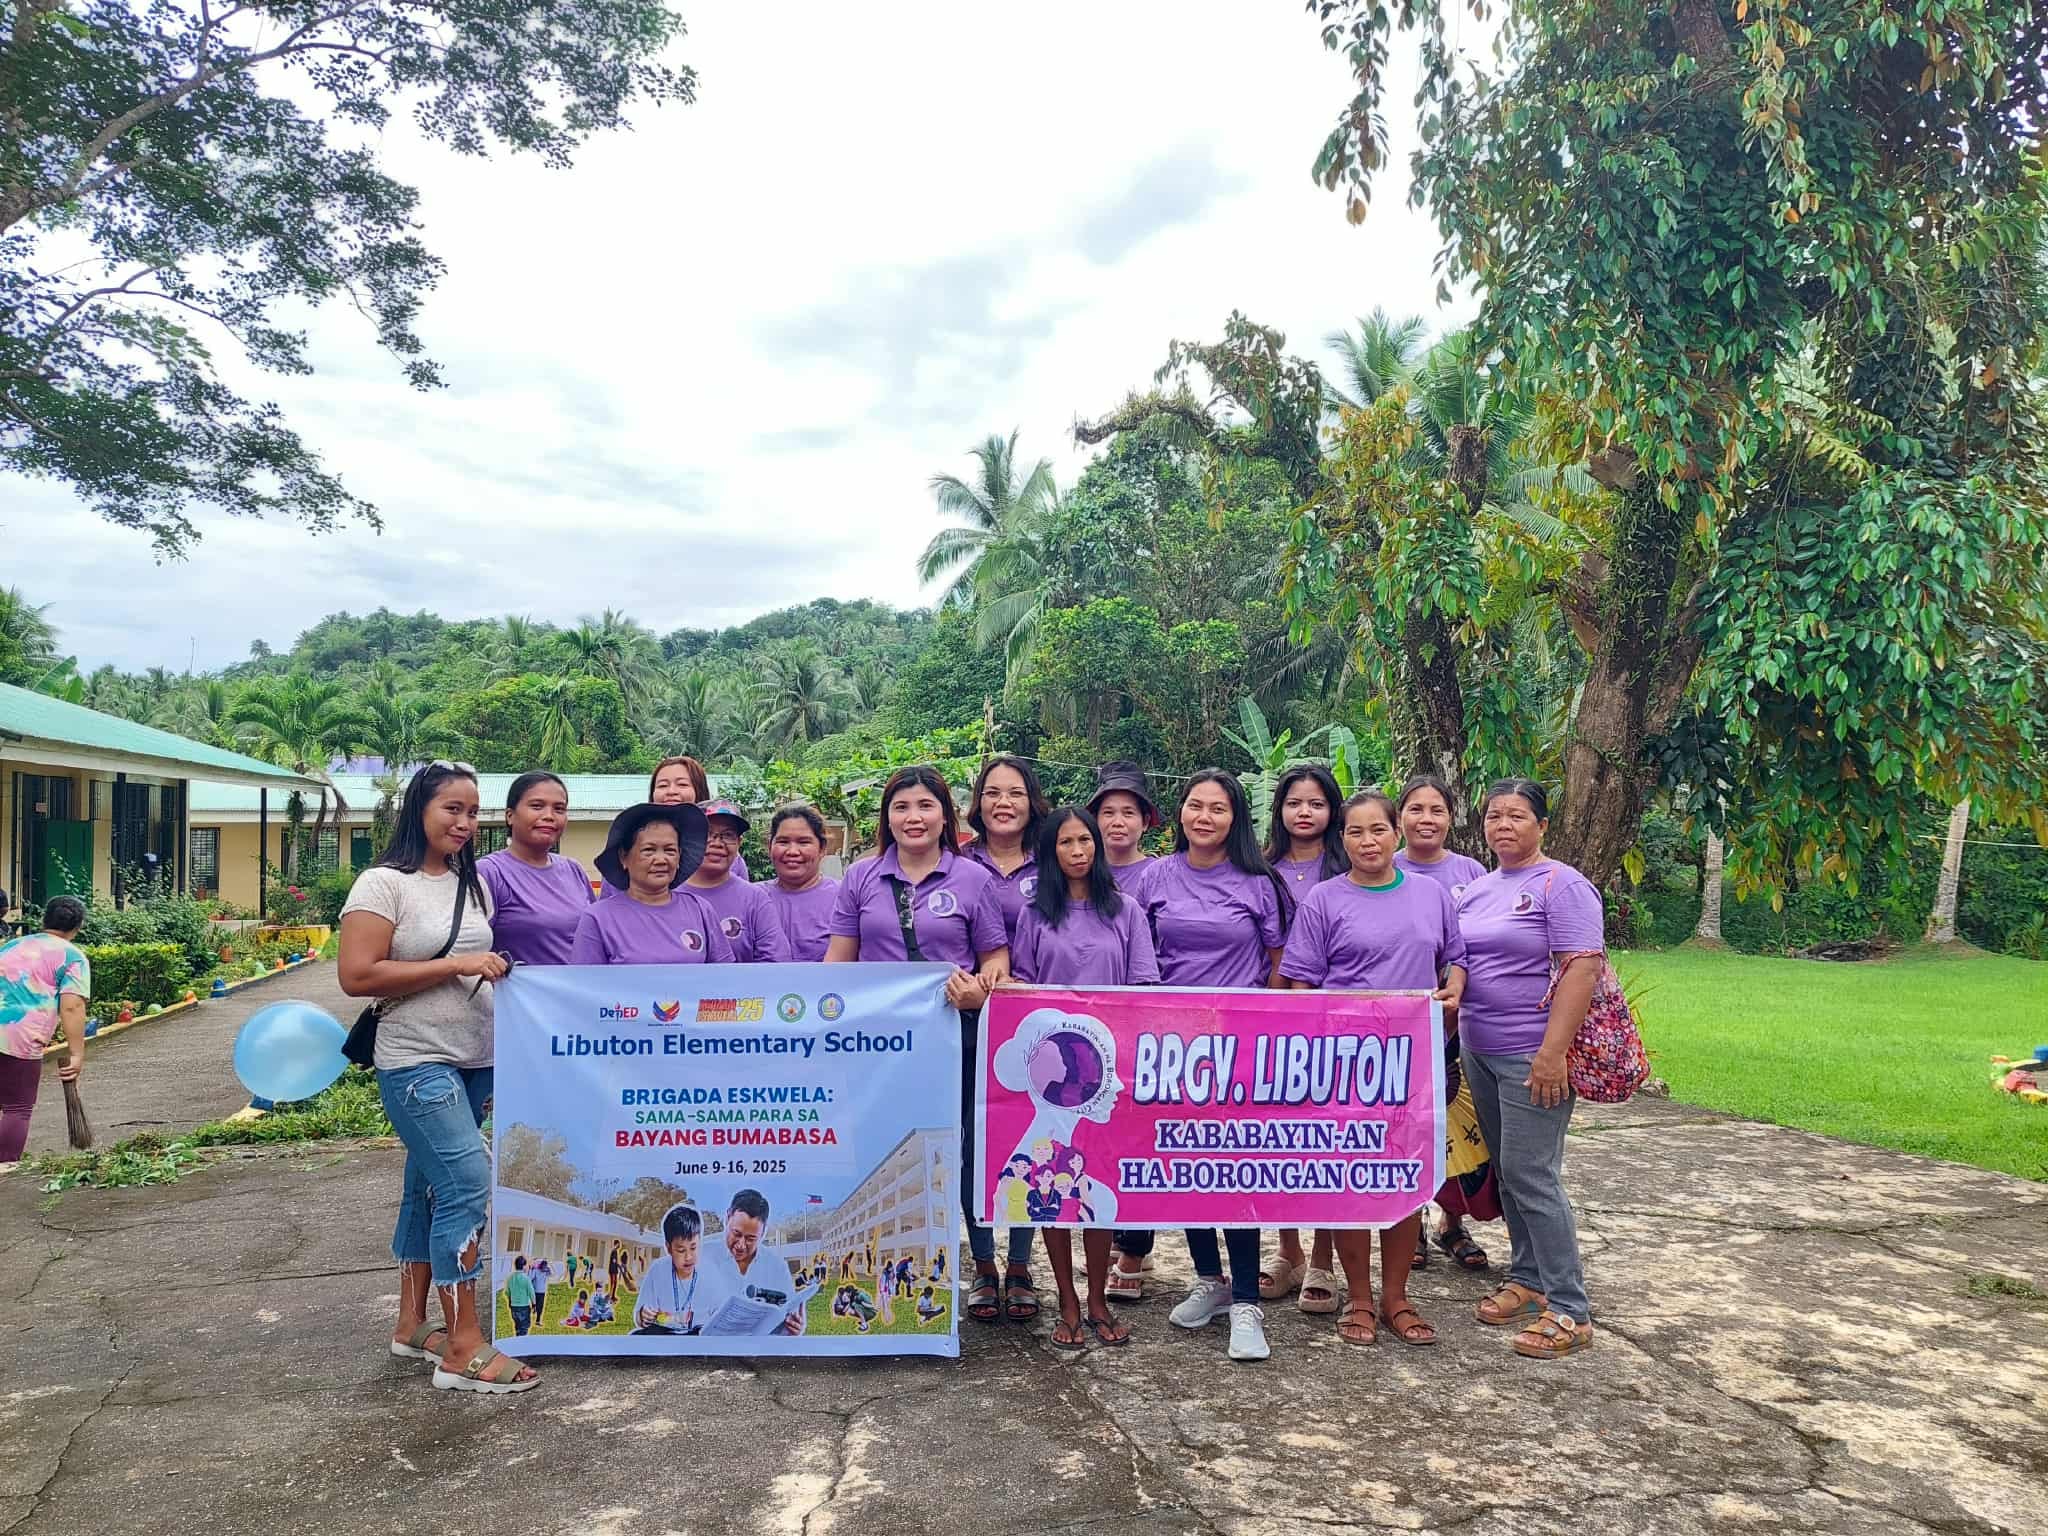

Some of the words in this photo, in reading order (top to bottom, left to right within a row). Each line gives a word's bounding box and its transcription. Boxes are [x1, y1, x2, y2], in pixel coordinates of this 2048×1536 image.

[551, 1035, 653, 1056] Libuton
[663, 1033, 816, 1058] Elementary
[824, 1031, 913, 1053] School
[1133, 1032, 1246, 1105] BRGY.
[1252, 1033, 1413, 1106] LIBUTON
[622, 1088, 722, 1106] BRIGADA
[727, 1087, 834, 1103] ESKWELA:
[635, 1109, 745, 1124] SAMA-SAMA
[750, 1109, 794, 1122] PARA
[798, 1108, 819, 1122] SA
[615, 1130, 707, 1147] BAYANG
[712, 1128, 837, 1145] BUMABASA
[1157, 1122, 1385, 1150] KABABAYIN-AN
[674, 1161, 708, 1175] June
[712, 1160, 749, 1176] 9-16,
[752, 1160, 786, 1174] 2025
[1120, 1161, 1168, 1190] HA
[1171, 1161, 1345, 1191] BORONGAN
[1349, 1162, 1420, 1190] CITY
